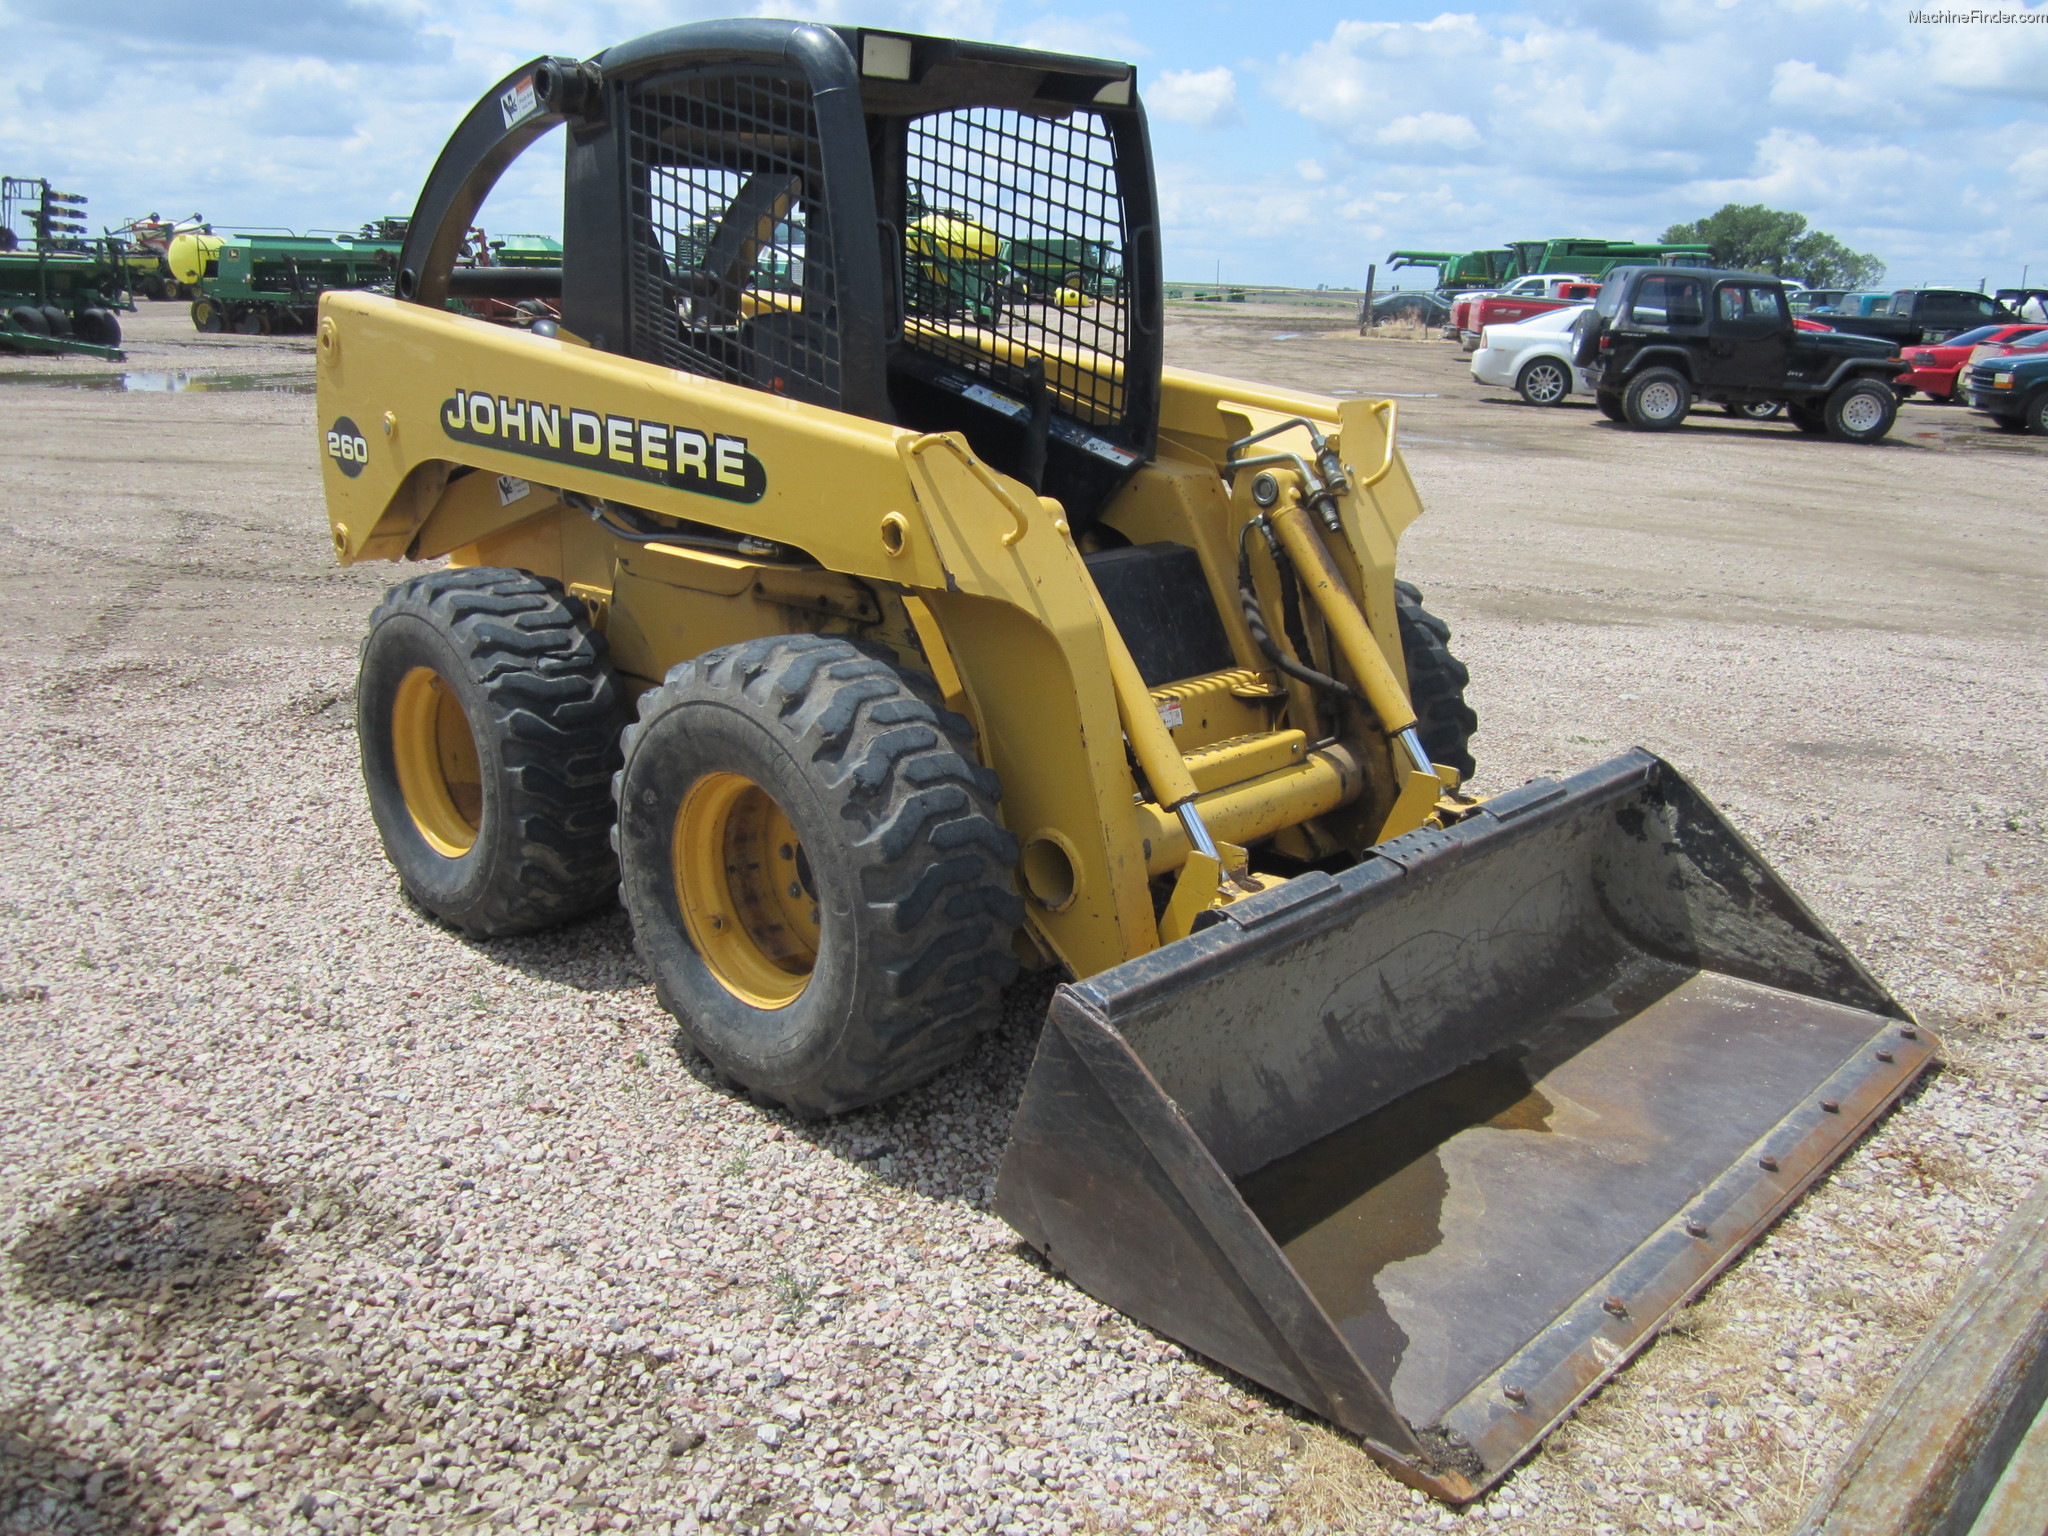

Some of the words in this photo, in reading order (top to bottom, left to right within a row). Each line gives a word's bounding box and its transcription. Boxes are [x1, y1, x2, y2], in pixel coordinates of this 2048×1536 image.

[327, 431, 369, 464] 260
[446, 391, 562, 449] JOHN
[571, 411, 747, 488] DEERE
